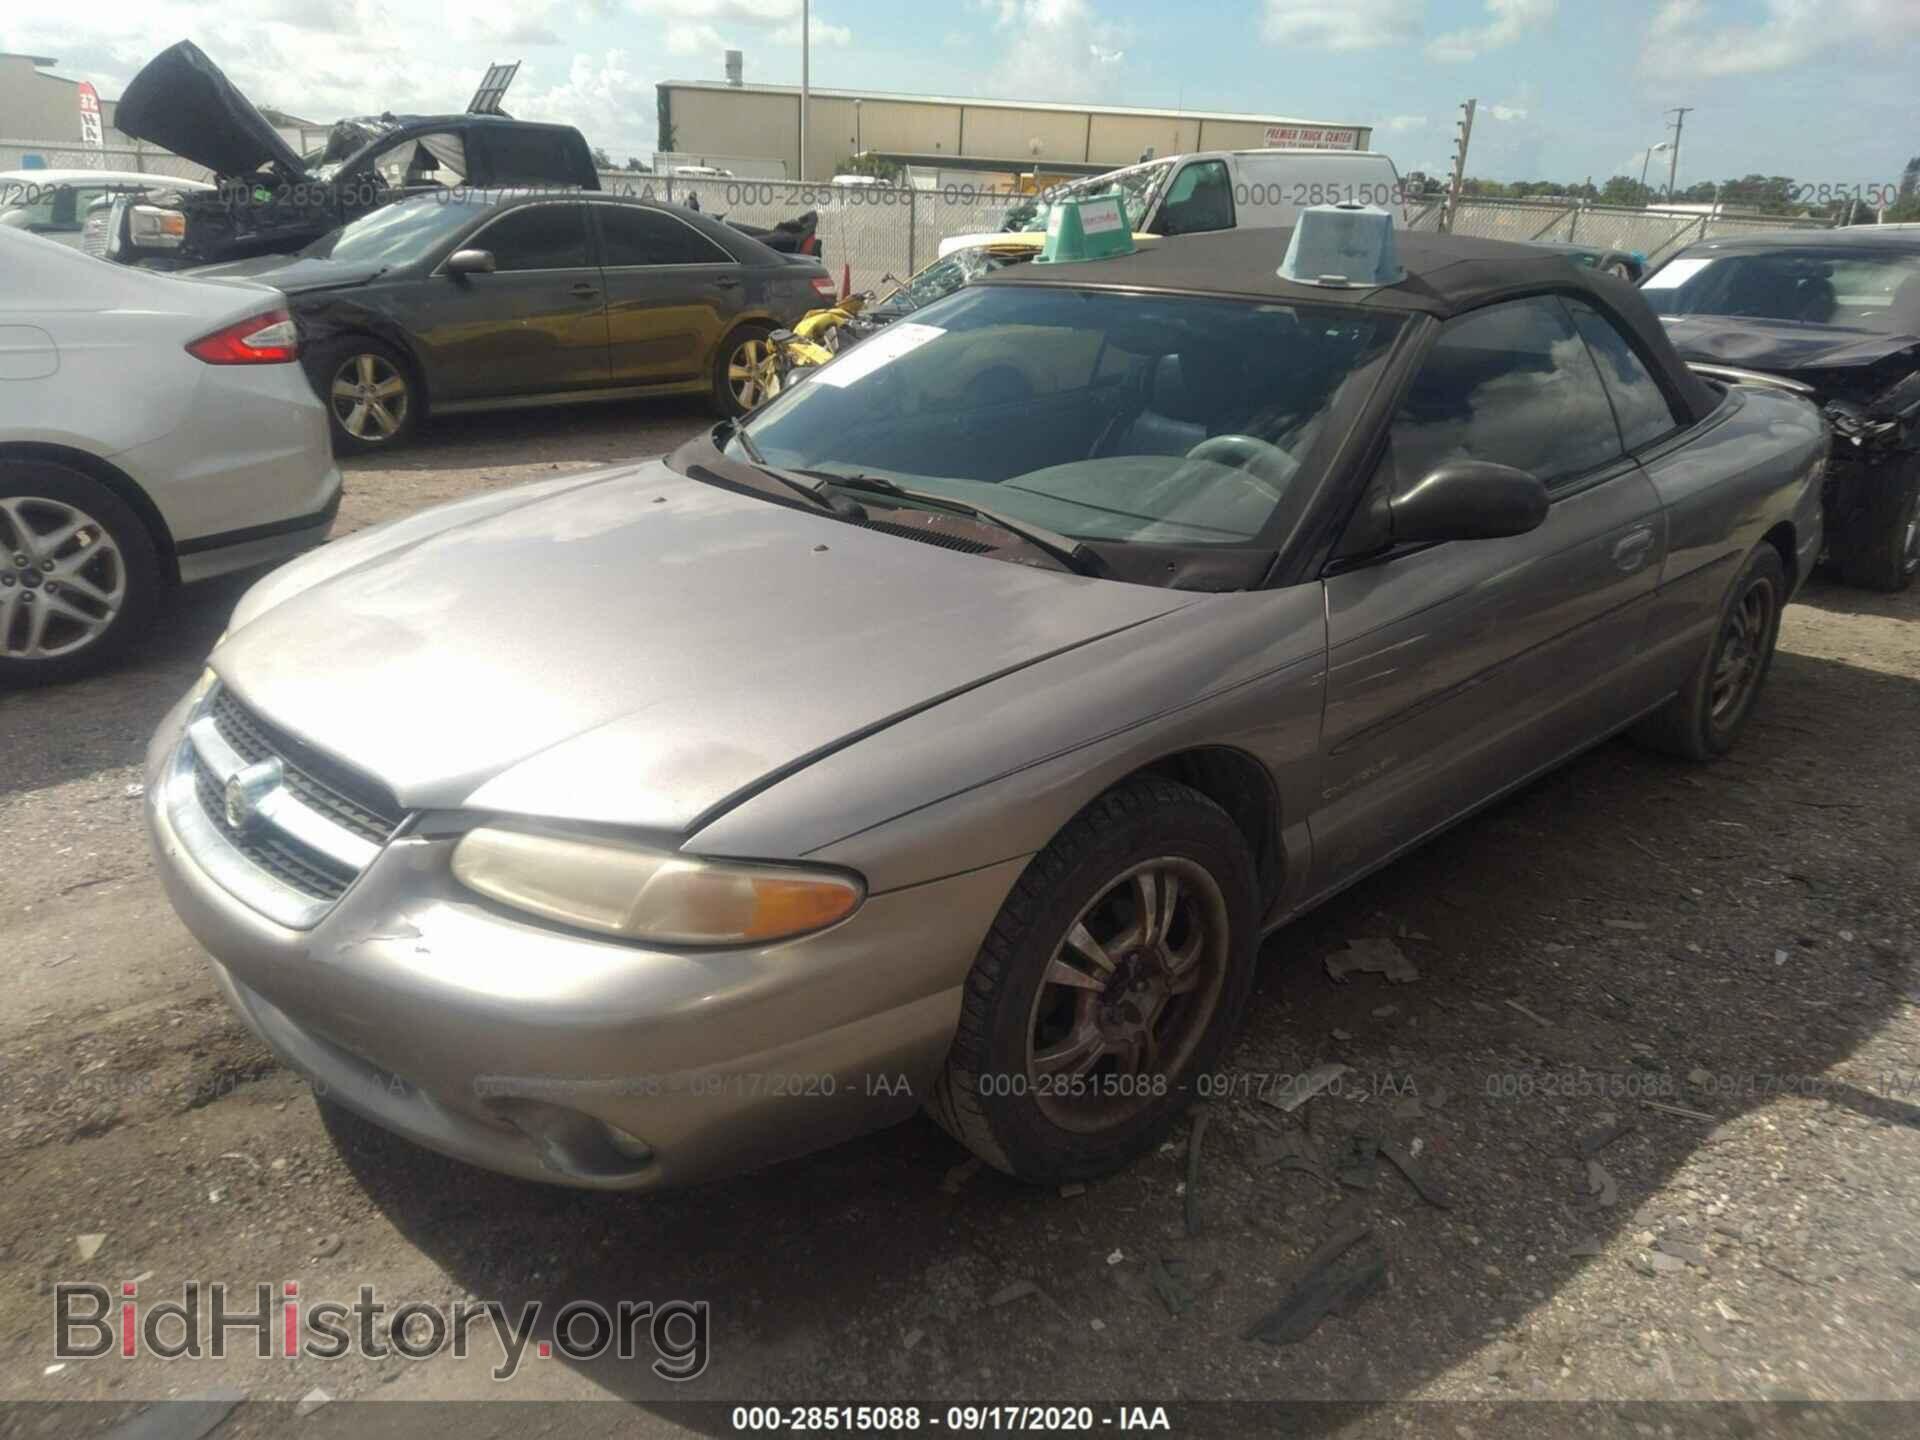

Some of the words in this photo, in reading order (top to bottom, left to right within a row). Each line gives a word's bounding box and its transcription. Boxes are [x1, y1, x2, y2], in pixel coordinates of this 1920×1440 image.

[1265, 128, 1297, 140] PREMIER
[1299, 129, 1322, 141] TRUCK
[1325, 130, 1352, 143] CENTER
